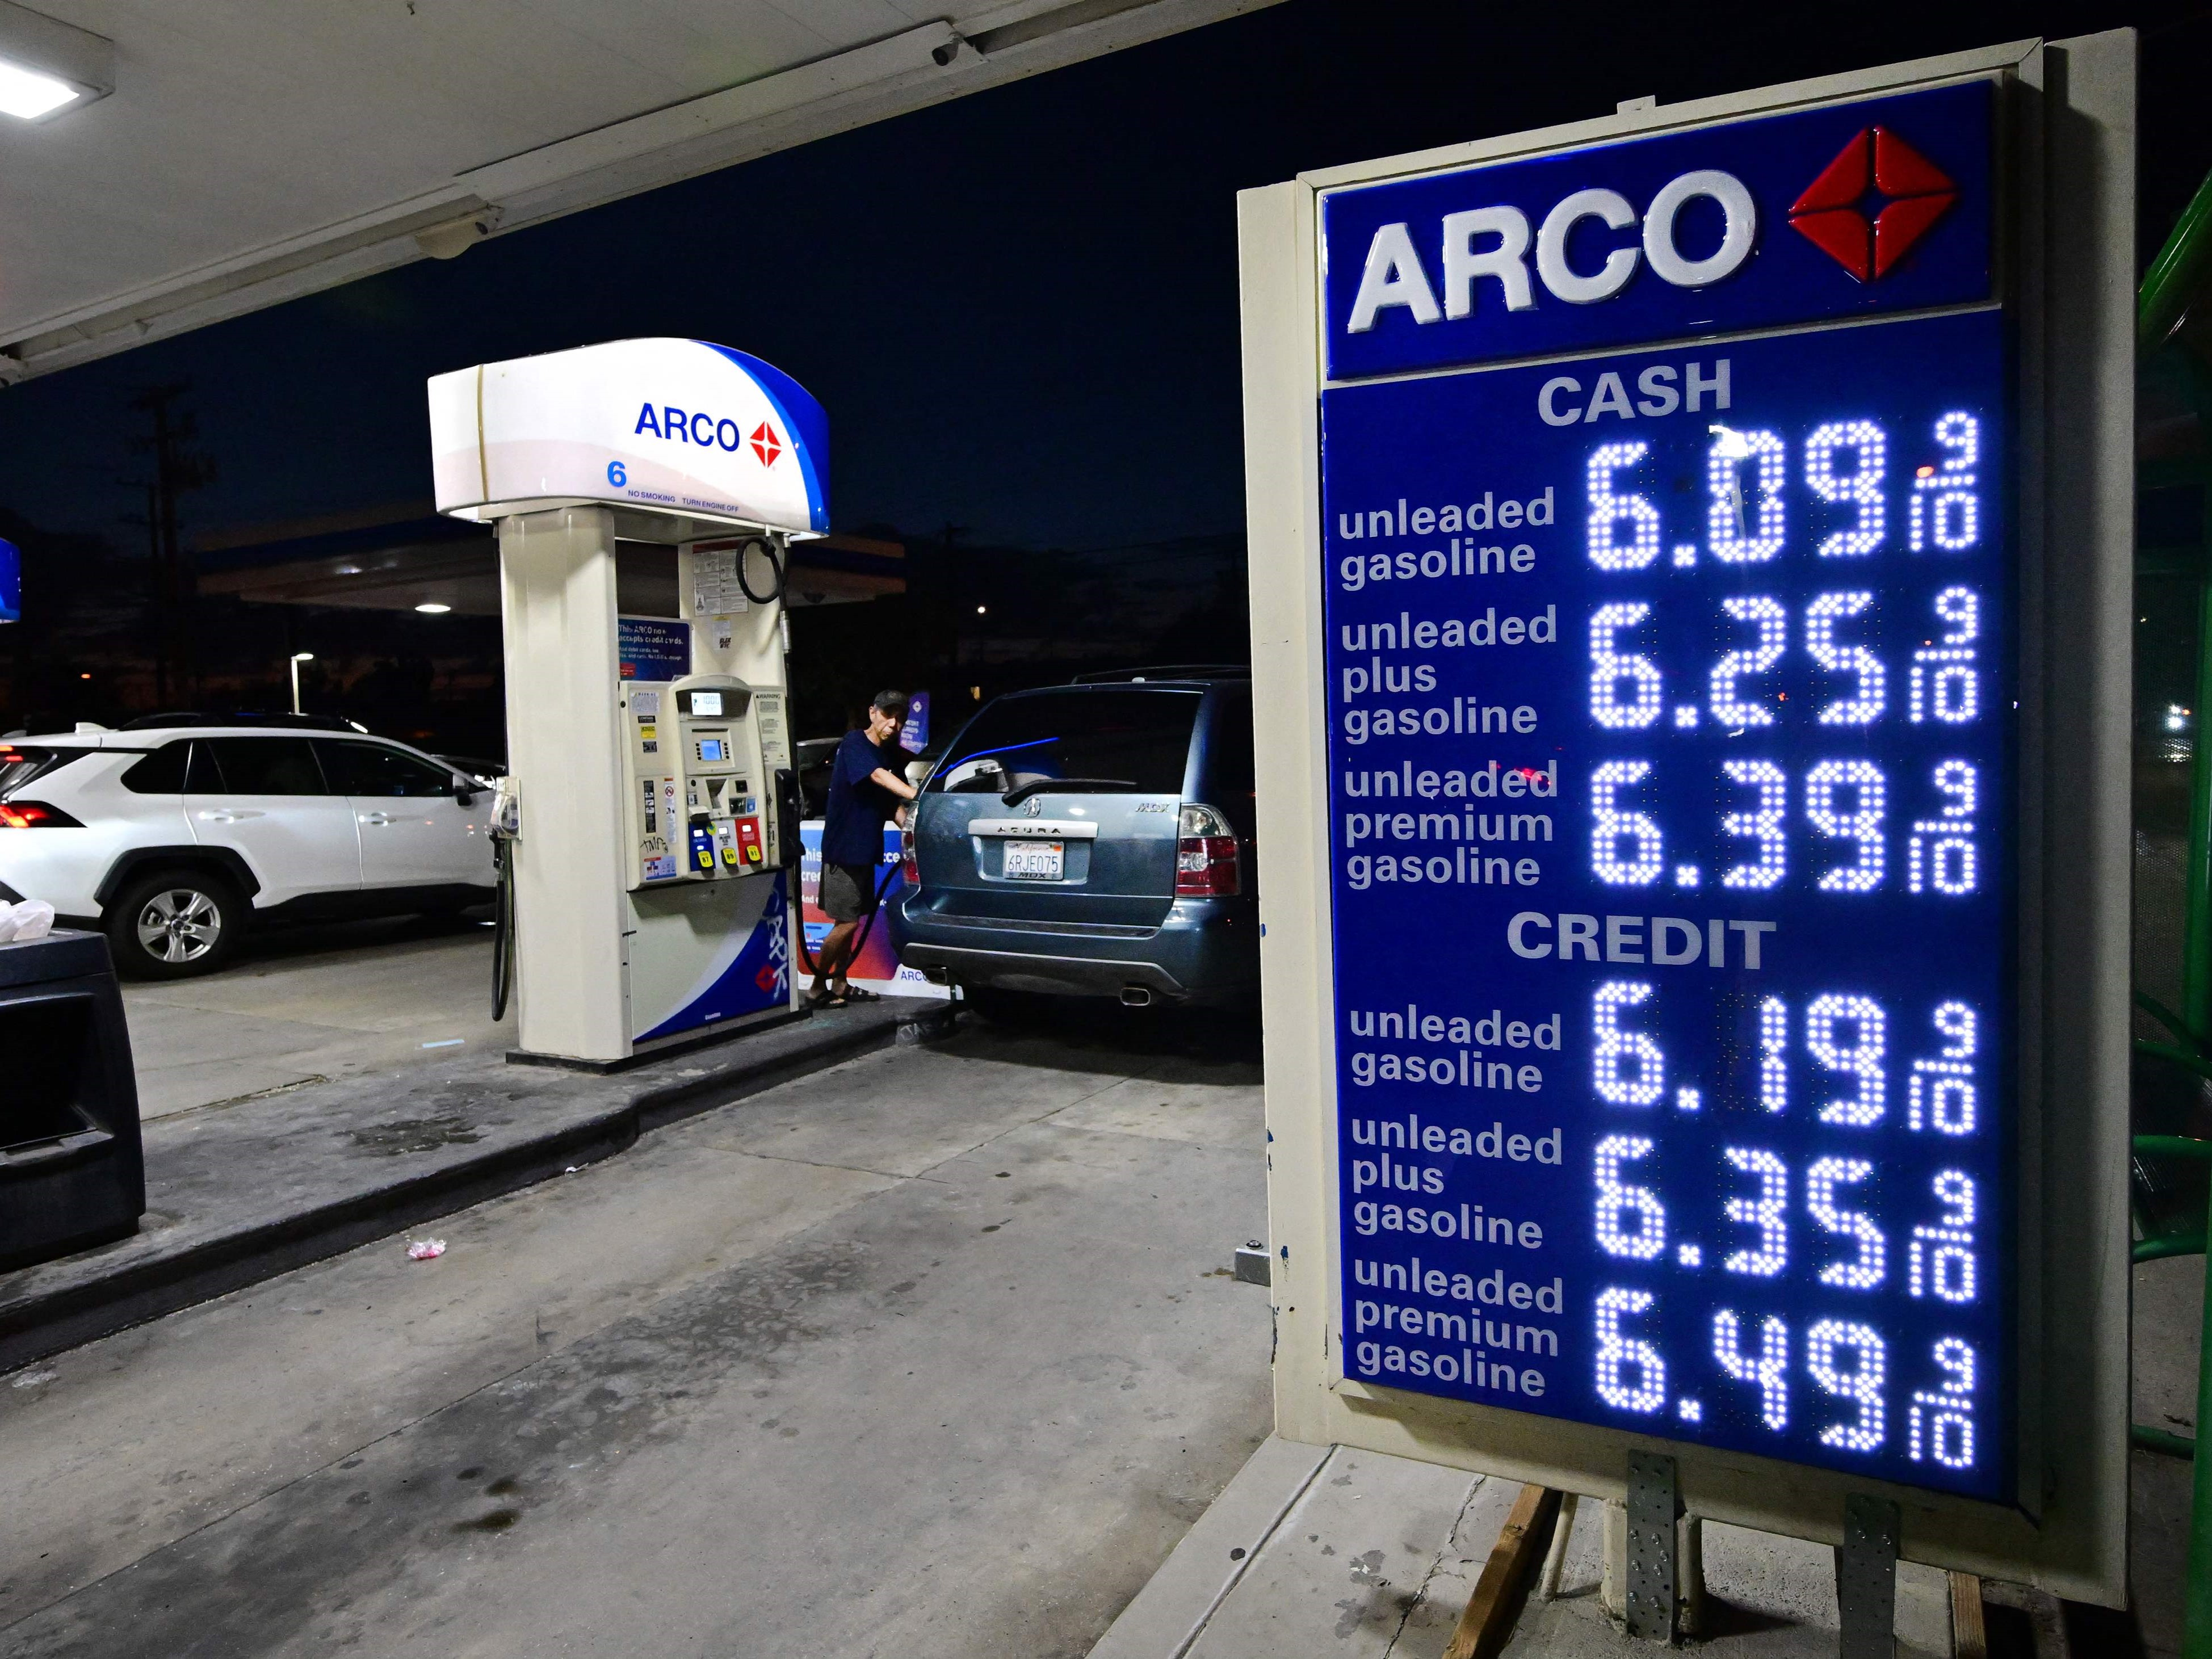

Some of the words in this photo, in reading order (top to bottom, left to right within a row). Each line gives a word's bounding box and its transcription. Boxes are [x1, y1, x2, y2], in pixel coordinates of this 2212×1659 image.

[1348, 169, 1758, 334] ARCO
[1538, 359, 1731, 427] CASH
[635, 402, 739, 452] ARCO
[607, 460, 627, 488] 6
[628, 489, 640, 498] NO
[641, 491, 675, 503] SMOKING
[682, 497, 701, 507] TURN
[702, 501, 726, 511] ENGINE
[1340, 486, 1554, 539] unleaded
[1341, 537, 1536, 591] gasoline
[1342, 604, 1557, 651] unleaded
[1344, 656, 1437, 703] plus
[1344, 697, 1538, 745] gasoline
[1345, 760, 1558, 798] unleaded
[1135, 803, 1170, 813] MDX
[1346, 804, 1553, 848] premium
[1008, 855, 1059, 872] 6RJE075
[1347, 846, 1541, 890] gasoline
[1508, 911, 1777, 970] CREDIT
[1351, 1004, 1562, 1051] unleaded
[1351, 1050, 1543, 1093] gasoline
[1352, 1114, 1562, 1165] unleaded
[1353, 1153, 1445, 1194] plus
[1354, 1200, 1543, 1249] gasoline
[1355, 1257, 1563, 1314] unleaded
[1356, 1298, 1558, 1357] premium
[1357, 1339, 1545, 1397] gasoline
